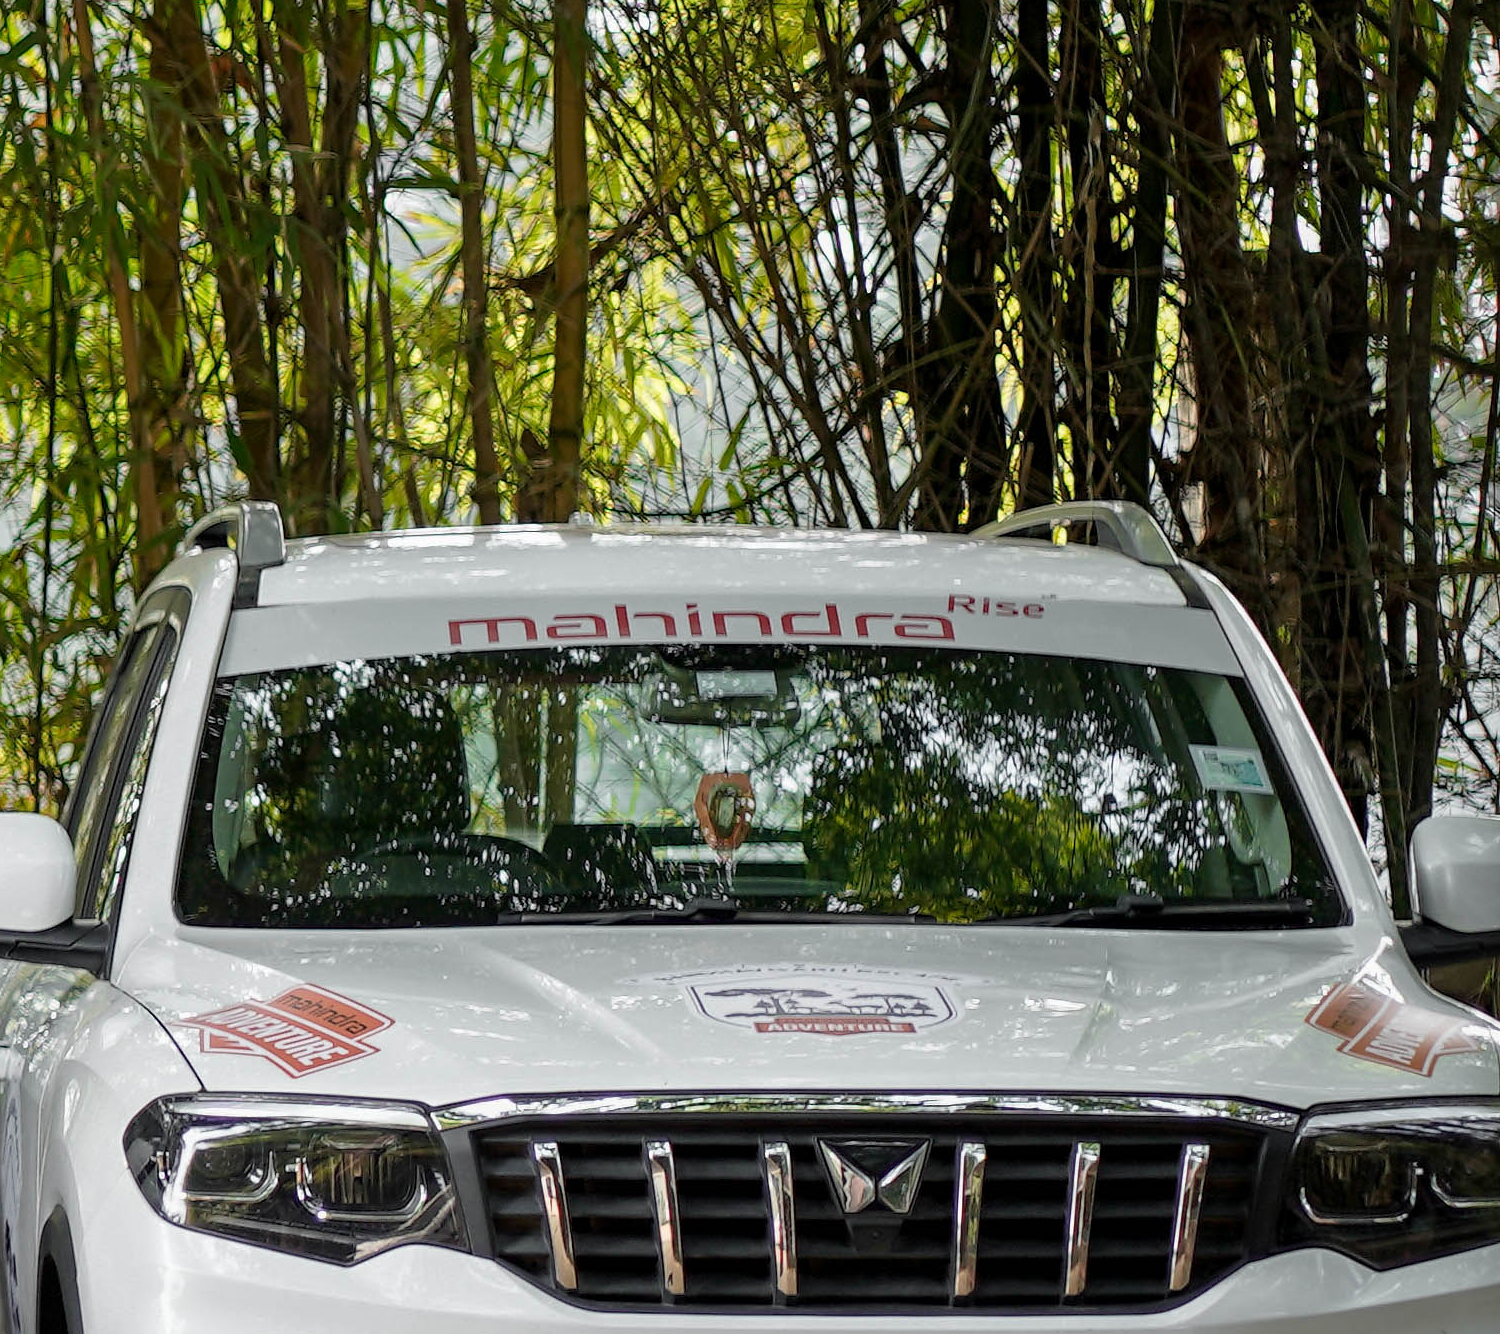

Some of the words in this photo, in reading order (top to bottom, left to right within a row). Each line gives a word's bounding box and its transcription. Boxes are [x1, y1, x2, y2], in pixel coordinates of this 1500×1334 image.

[448, 603, 956, 646] mahindra
[277, 994, 369, 1036] mahindra
[202, 1007, 350, 1067] ADVENTURE
